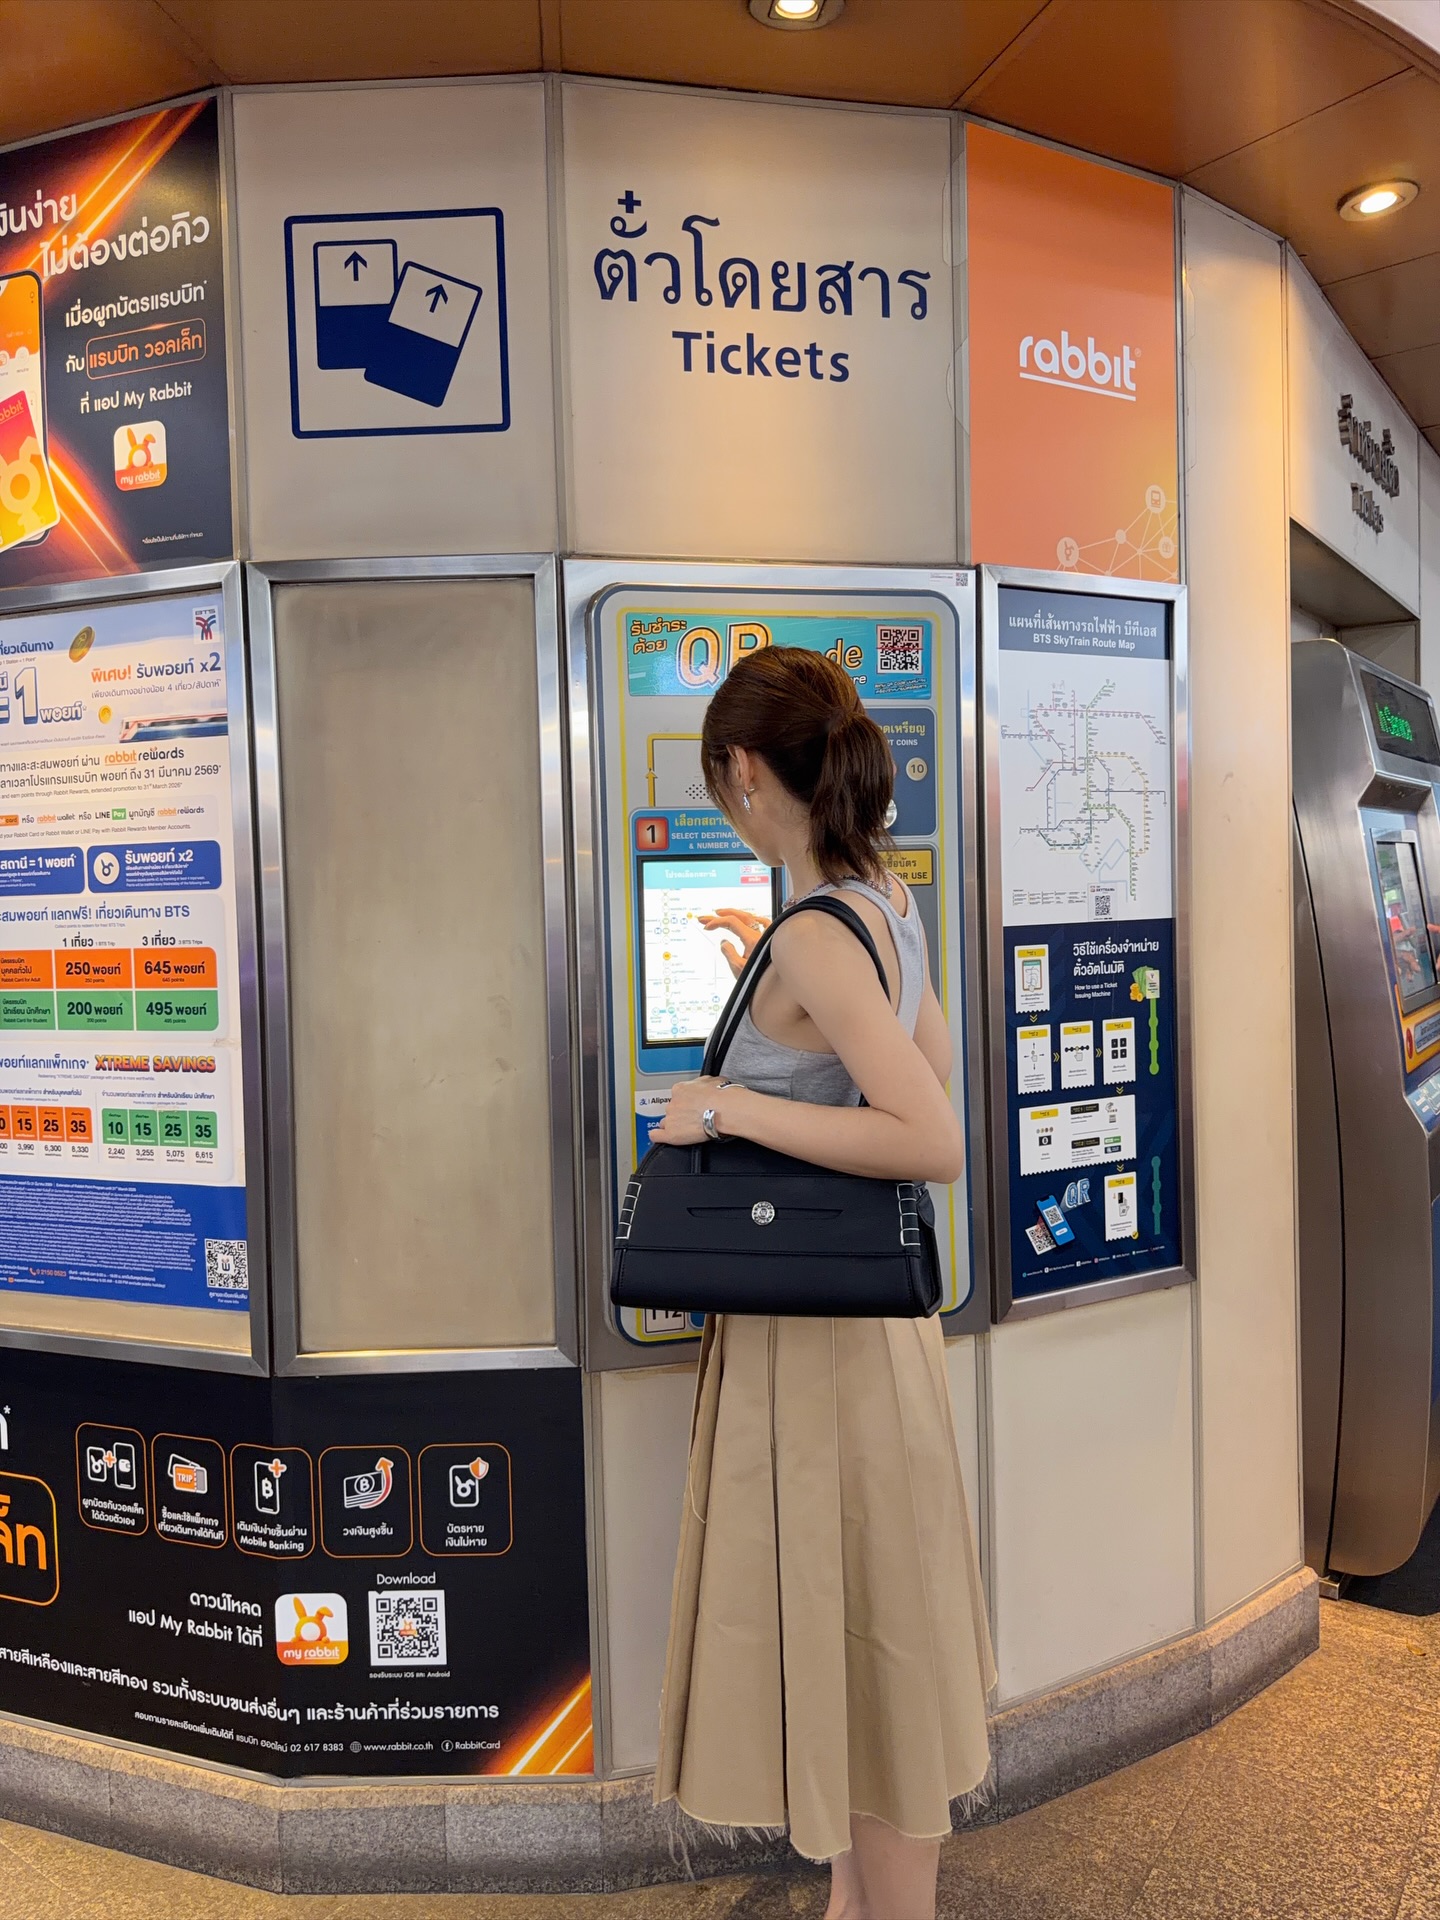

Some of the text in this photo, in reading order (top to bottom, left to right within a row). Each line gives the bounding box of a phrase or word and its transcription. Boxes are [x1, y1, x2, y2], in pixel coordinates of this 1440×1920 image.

[40, 211, 210, 277] ไม่ต้องต่อคิว
[593, 190, 931, 321] ตั๋วโดยสาร
[66, 327, 203, 373] กับ แรบบิท วอลเล็ท
[672, 330, 850, 383] Tickets
[1019, 330, 1137, 391] rabbit
[80, 381, 193, 414] ที่ แอป My Rabbit
[0, 400, 24, 421] abbit
[120, 469, 161, 486] my rabbit
[631, 617, 687, 637] รับชำระ
[1009, 609, 1158, 639] แผนที่เส้นทางรถไฟฟ้า บีทีเอส
[633, 637, 668, 655] ด้วย
[1033, 633, 1136, 651] BTS SkyTrain Route Map
[91, 651, 221, 684] พิเศษ! รับพอยท์ x2
[167, 683, 173, 691] 4
[896, 738, 918, 746] COINS
[82, 754, 100, 767] ผ่าน
[105, 748, 137, 763] rabbit
[138, 747, 185, 761] rewards
[100, 768, 127, 782] พอยท์
[130, 768, 142, 780] ถึง
[144, 768, 155, 779] 31
[158, 765, 191, 778] มีนาคม
[911, 764, 925, 774] 10
[95, 811, 110, 819] LINE
[113, 810, 125, 818] Pay
[177, 806, 205, 815] rewards
[646, 824, 656, 844] 1
[671, 832, 699, 840] SELECT
[0, 855, 28, 870] สถานี
[38, 856, 43, 868] 1
[125, 847, 194, 864] รับพอยท์ x2
[911, 872, 928, 880] USE
[51, 905, 92, 920] แลกฟรี!
[95, 900, 162, 920] เที่ยวเดินทาง
[165, 905, 191, 918] BTS
[62, 931, 94, 947] 1 เที่ยว
[142, 930, 176, 946] 3 เที่ยว
[1073, 937, 1160, 957] วิธีใช้เครื่องจำหน่าย
[65, 962, 121, 976] 250 พอยท์
[144, 961, 206, 974] 645 พอยท์
[1073, 958, 1125, 976] ตั๋วอัตโนมัติ
[67, 1002, 123, 1016] 200 พอยท์
[146, 1002, 207, 1015] 495 พอยท์
[94, 1054, 150, 1073] XTREME
[153, 1054, 216, 1073] SAVINGS
[17, 1117, 212, 1138] 15 25 35 10 15 25 35
[17, 1143, 35, 1152] 3,990
[44, 1144, 62, 1153] 6,300
[107, 1147, 126, 1156] 2,240
[135, 1149, 155, 1157] 3,255
[166, 1150, 185, 1158] 5,075
[195, 1151, 213, 1159] 6,615
[1065, 1178, 1091, 1209] QR
[176, 1472, 193, 1483] TRIP
[82, 1498, 144, 1515] ผูกบัตรกับวอลเล็ท
[91, 1510, 136, 1526] ได้ด้วยตัวเอง
[161, 1505, 219, 1527] ซื้อและใช้แพ็กเกจ
[158, 1518, 225, 1541] เที่ยวเดินทางได้ทันที
[237, 1521, 307, 1537] เติมเงินง่ายขึ้นผ่าน
[342, 1522, 393, 1539] วงเงินสูงขึ้น
[447, 1523, 485, 1534] บัตรหาย
[240, 1535, 304, 1552] Mobile Banking
[445, 1536, 488, 1548] เงินไม่หาย
[376, 1572, 436, 1586] Download
[190, 1591, 262, 1618] ดาวน์โหลด
[129, 1609, 263, 1648] แอป My Rabbit ได้ที่
[283, 1647, 340, 1659] my rabbit
[427, 1670, 450, 1678] Android
[0, 1647, 499, 1726] สายสีเหลืองและสายสีทอง รวมทั้งระบบขนส่งอื่นๆ และร้านค้าที่ร่วมรายการ
[236, 1733, 259, 1746] แรบบิท
[290, 1744, 301, 1753] 02
[303, 1743, 321, 1752] 617
[322, 1743, 344, 1752] 8383
[363, 1742, 433, 1751] www.rabbit.co.th
[455, 1740, 500, 1750] RabbitCard
